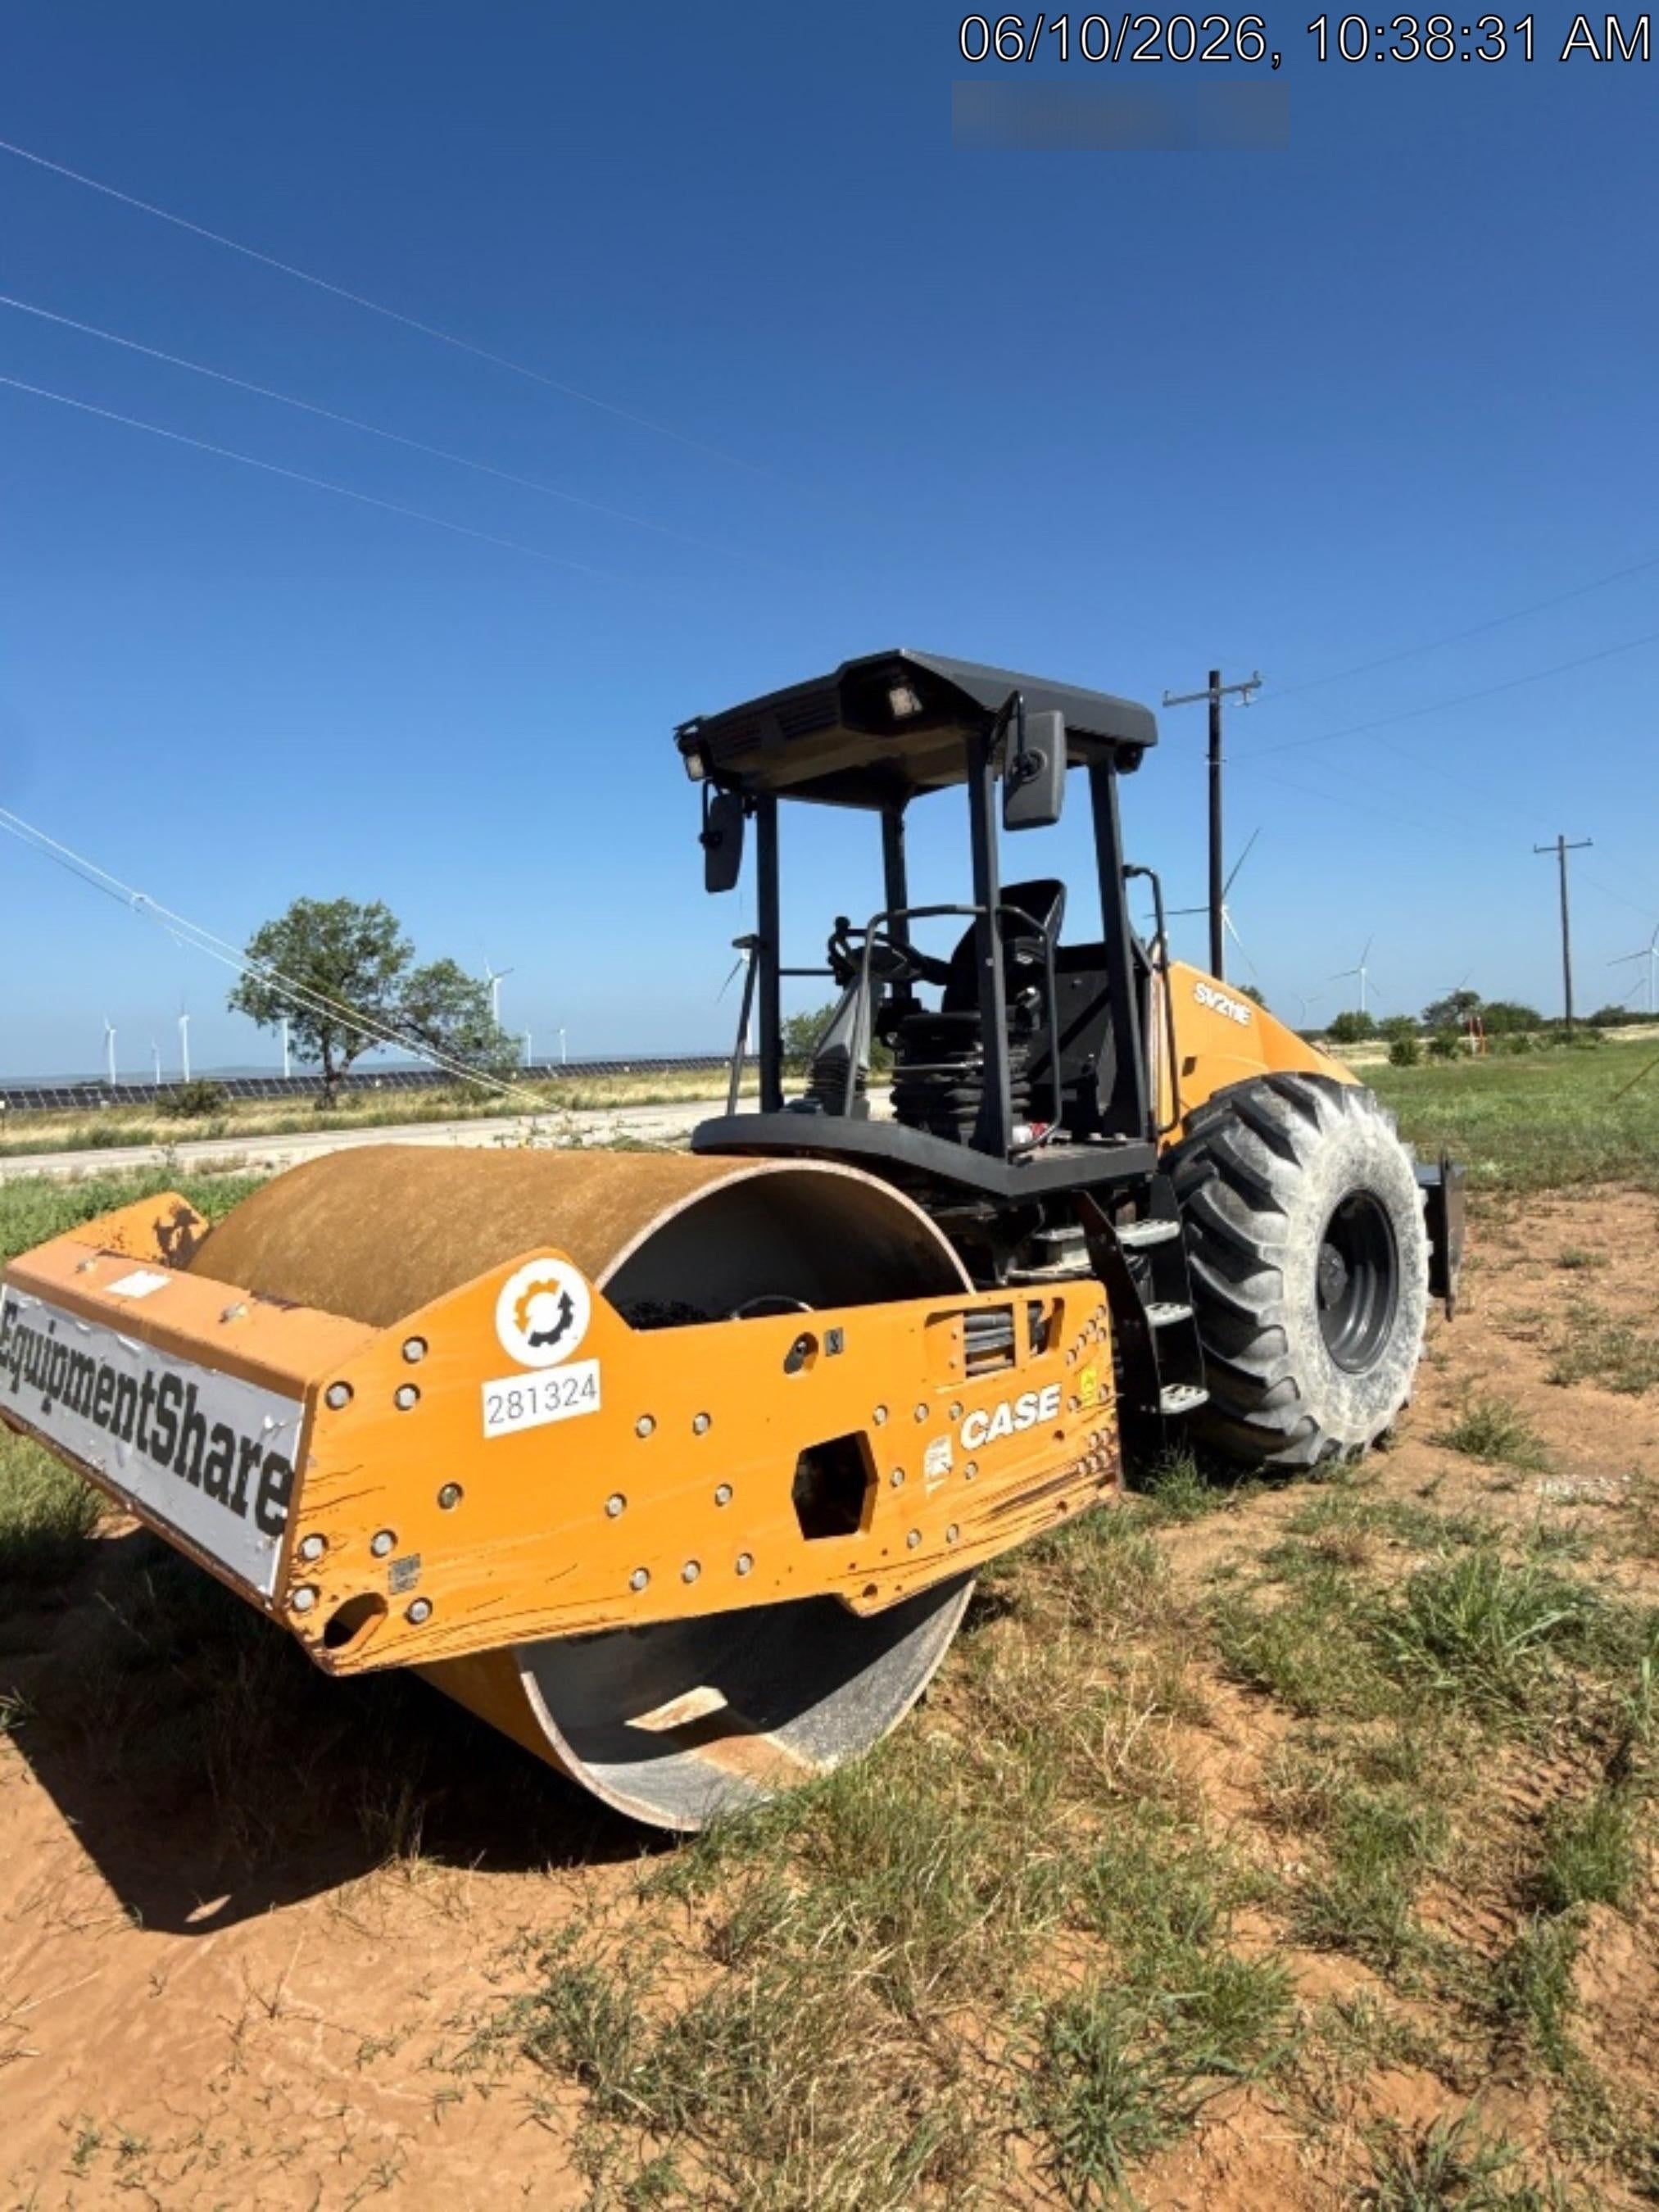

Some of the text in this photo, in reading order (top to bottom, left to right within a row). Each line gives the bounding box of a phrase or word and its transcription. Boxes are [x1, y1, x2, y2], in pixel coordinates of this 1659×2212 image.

[0, 1299, 295, 1537] EquipmentShare
[487, 1373, 596, 1424] 281324
[960, 1383, 1062, 1451] CASE
